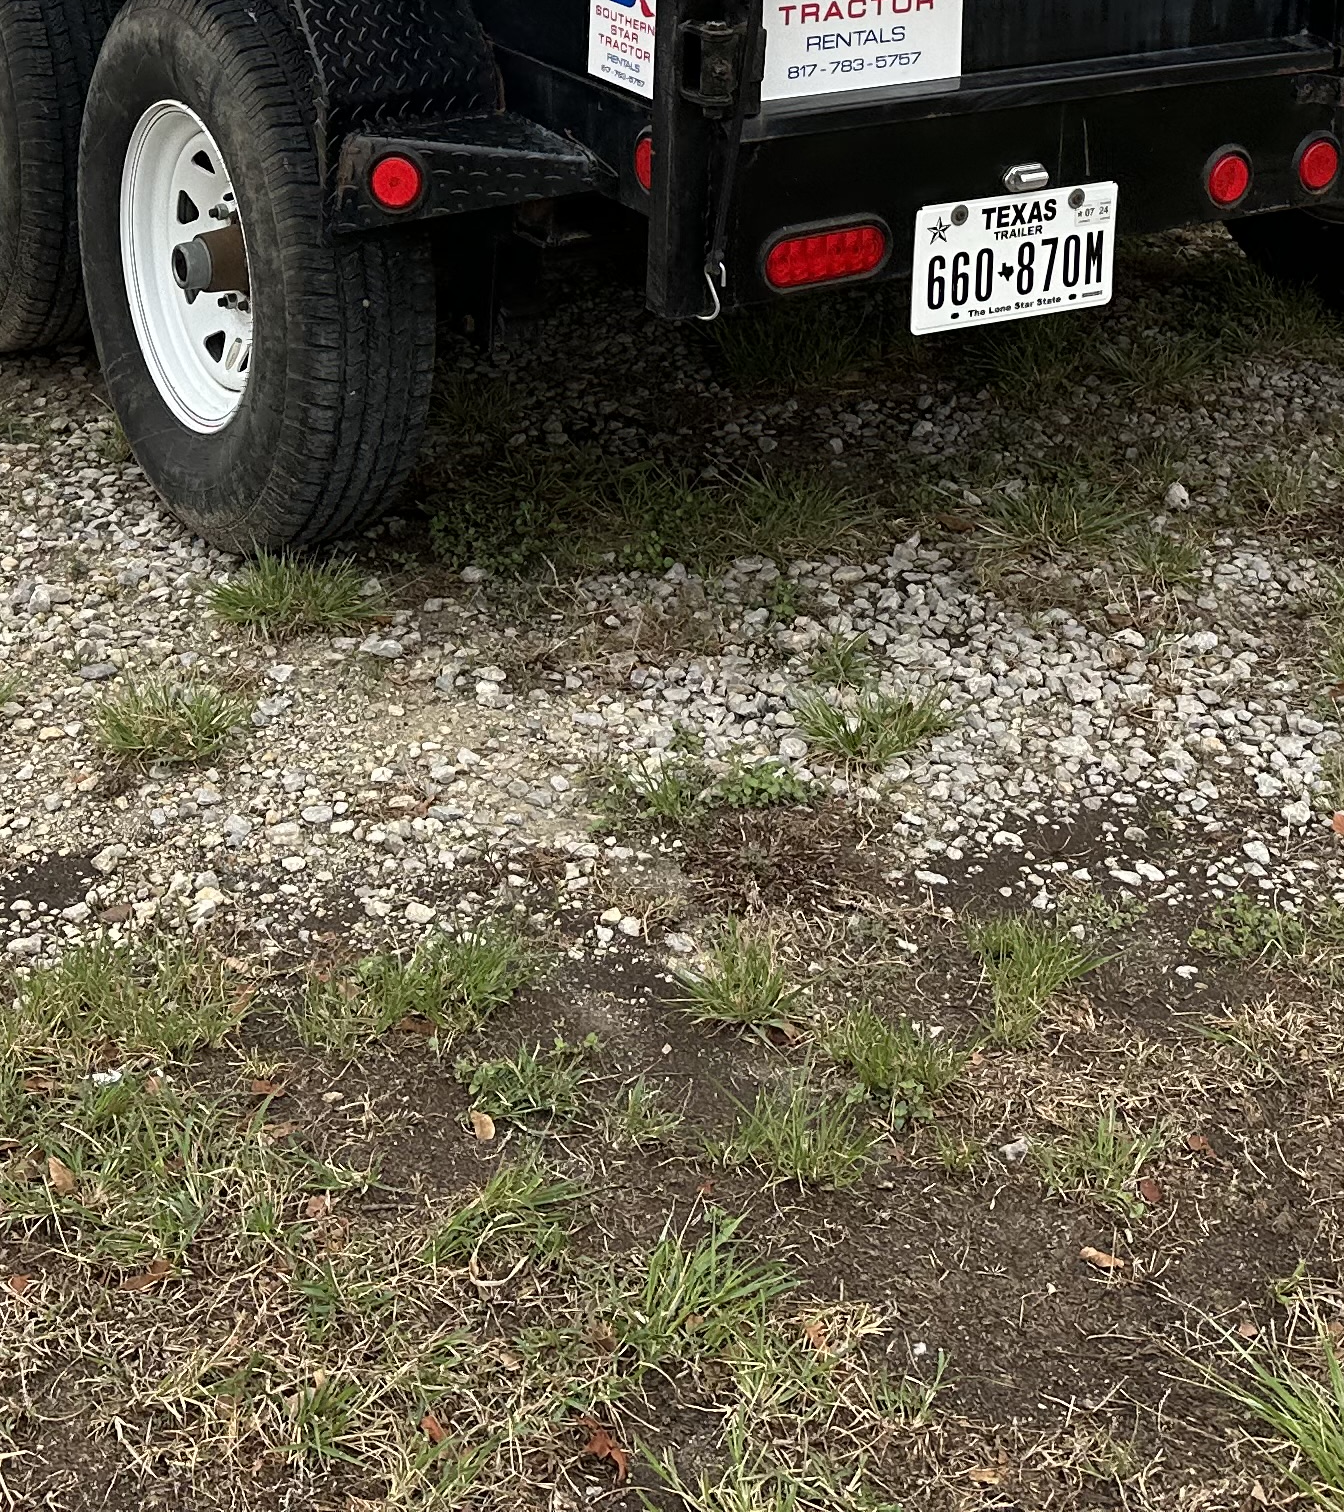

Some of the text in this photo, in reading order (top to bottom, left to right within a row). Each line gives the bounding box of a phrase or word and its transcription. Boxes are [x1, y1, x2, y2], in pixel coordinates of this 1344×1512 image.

[595, 4, 655, 37] SOUTHERN
[610, 24, 639, 44] STAR
[806, 26, 906, 52] RENTALS
[598, 33, 651, 63] TRACTOR
[606, 53, 641, 74] RENTALS
[982, 198, 1057, 230] TEXAS
[1084, 206, 1109, 217] 07 24
[993, 225, 1043, 241] TRAILER
[967, 295, 1062, 318] The Lone Star State
